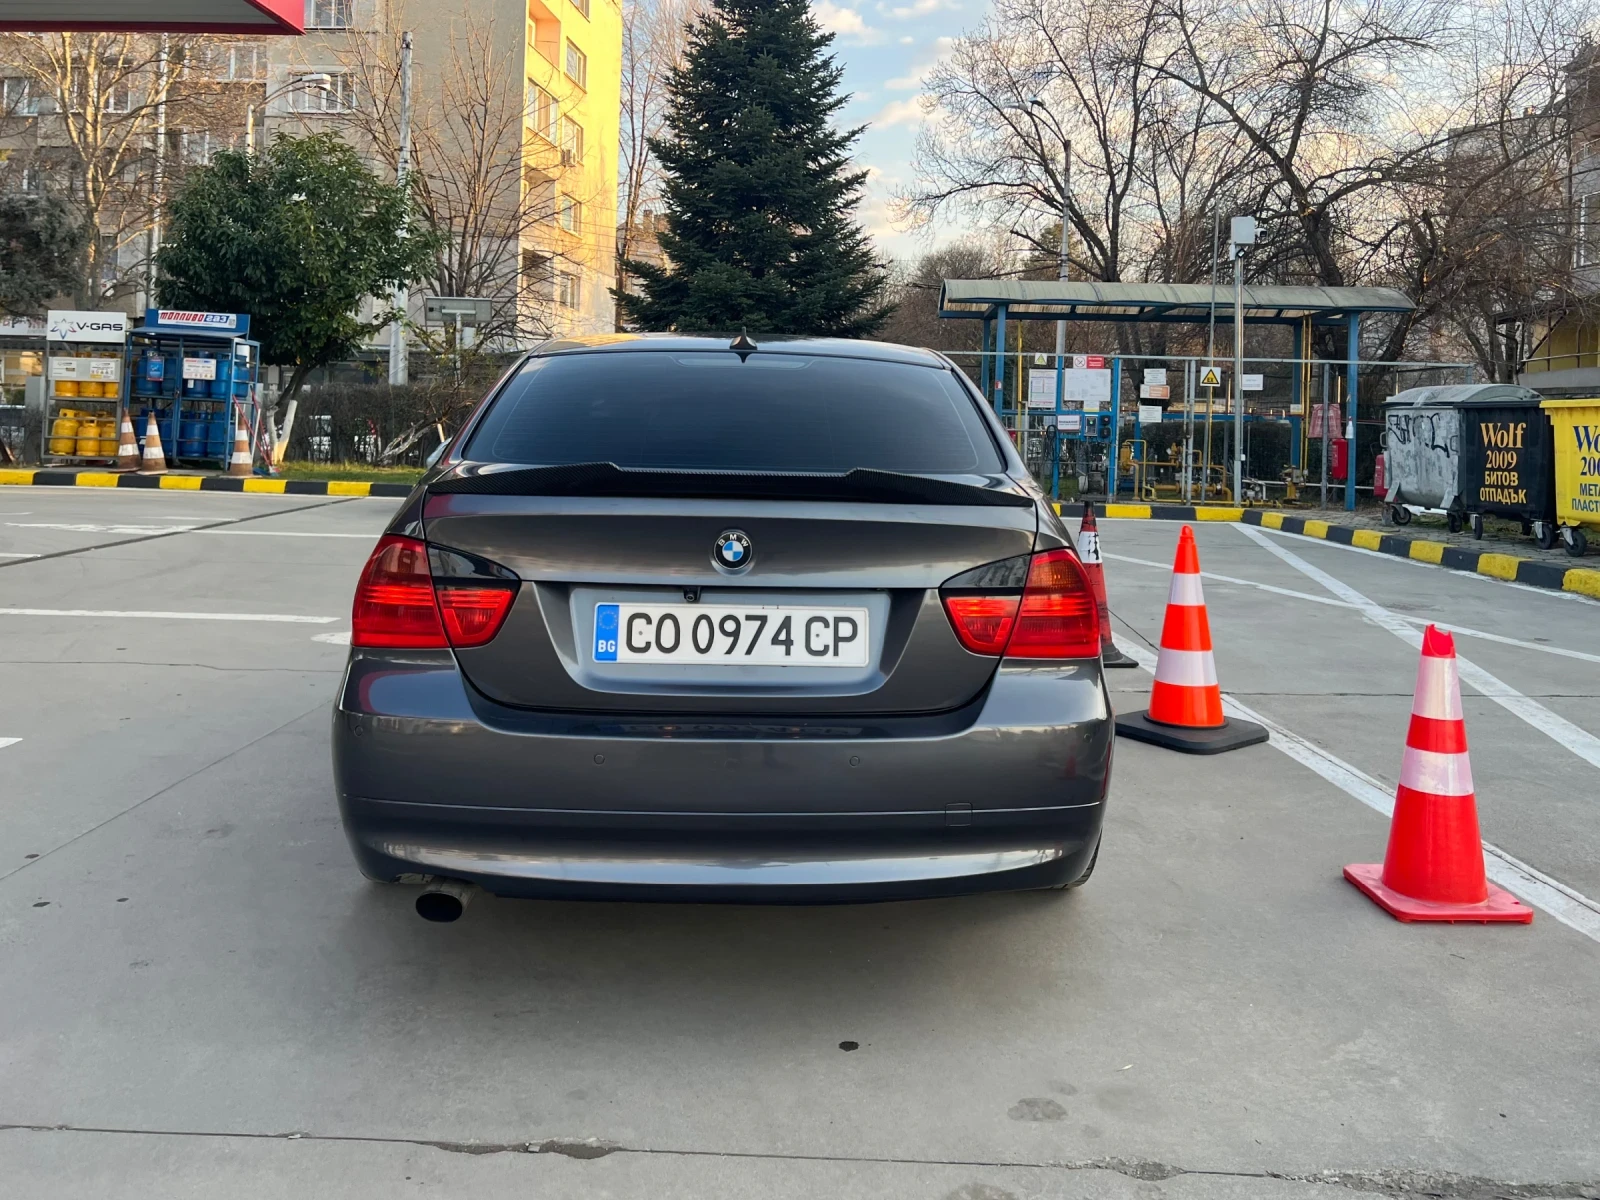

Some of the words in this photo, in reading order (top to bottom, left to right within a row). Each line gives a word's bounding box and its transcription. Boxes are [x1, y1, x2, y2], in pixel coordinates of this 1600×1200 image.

[76, 322, 123, 331] V-GAS
[1480, 422, 1526, 448] Wolf
[1485, 450, 1517, 469] 2009
[1485, 471, 1518, 486] БИТОВ
[1480, 487, 1526, 505] ОТПАДЪК
[1572, 498, 1600, 512] ПЛАСТ
[717, 533, 749, 547] BMW
[626, 612, 681, 654] CO
[691, 613, 794, 656] 0974
[804, 616, 858, 657] CP
[598, 640, 616, 653] BG
